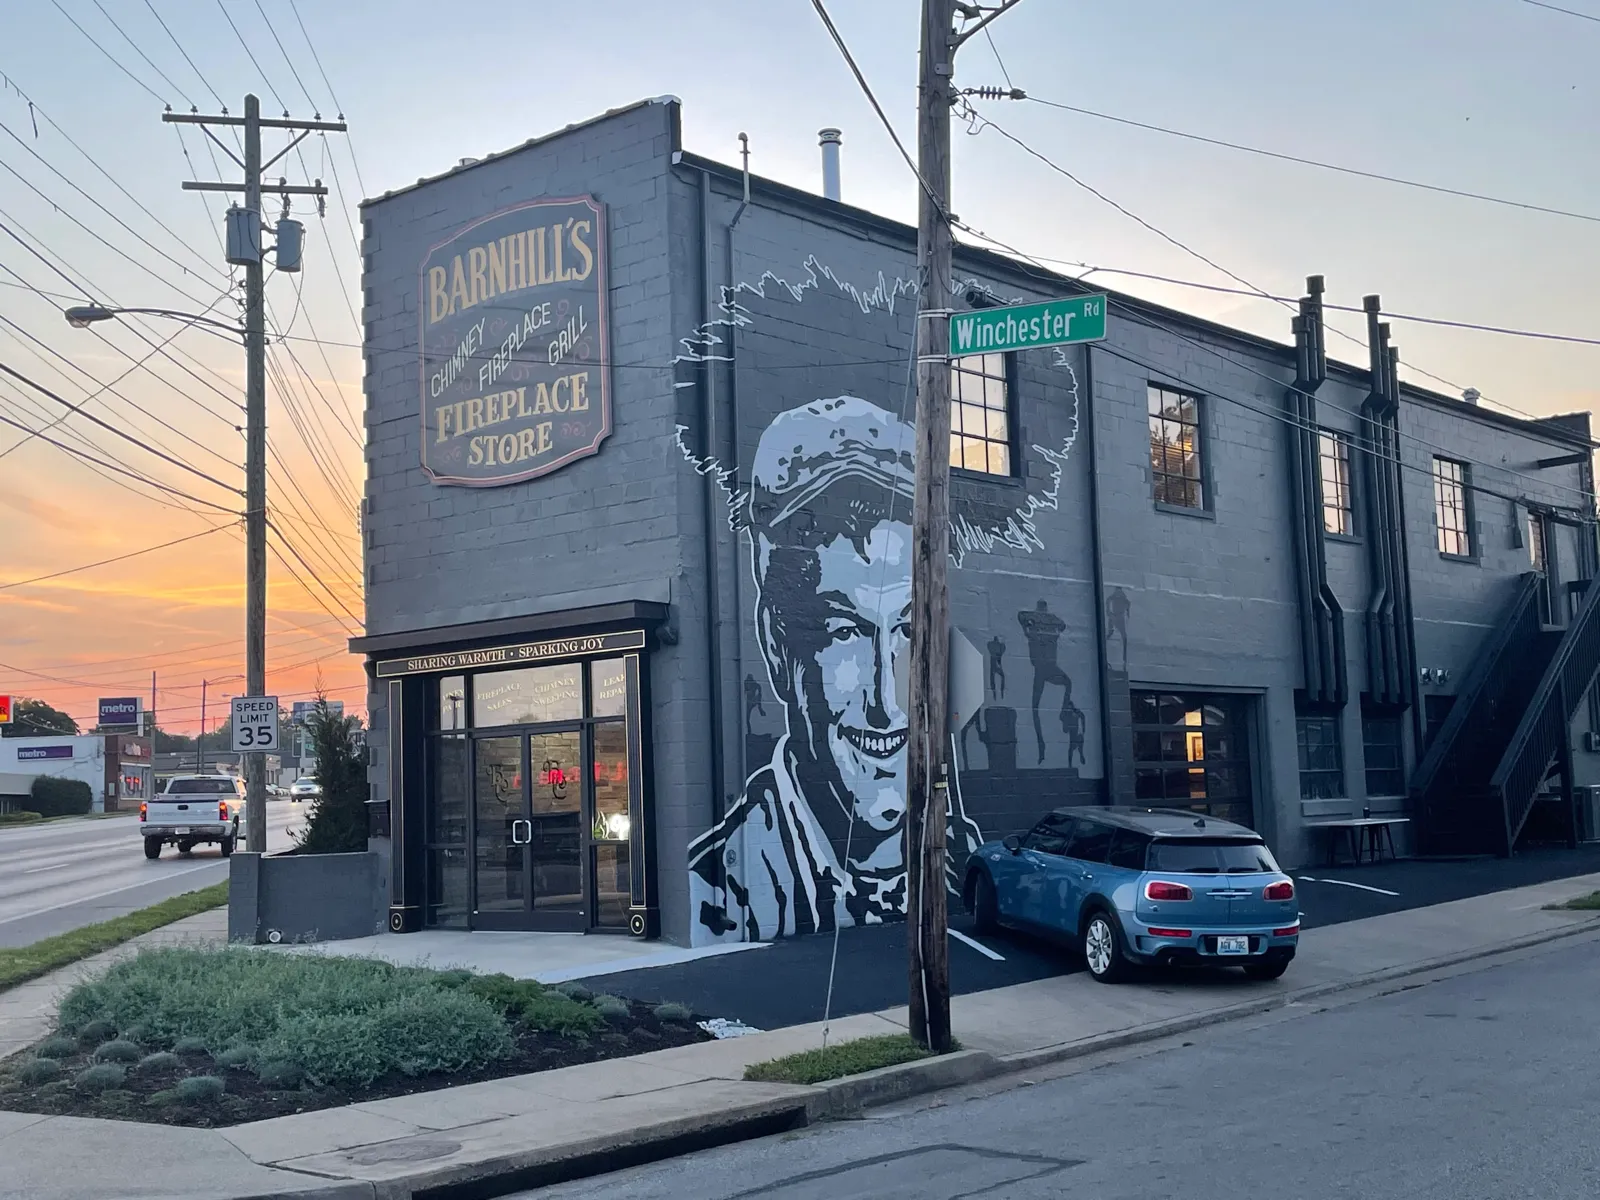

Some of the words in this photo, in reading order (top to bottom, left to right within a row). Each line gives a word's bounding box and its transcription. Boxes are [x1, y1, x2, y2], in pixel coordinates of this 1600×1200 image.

[429, 217, 593, 325] BARNHILL'S
[548, 305, 588, 367] GRILL
[956, 309, 1076, 350] Winchester
[1084, 302, 1099, 317] Rd
[479, 302, 551, 391] FIREPLACE
[431, 317, 486, 398] CHIMNEY
[435, 372, 589, 444] FIREPLACE
[467, 421, 553, 466] STORE
[408, 656, 456, 670] SHARING
[457, 650, 506, 665] WARMTH
[518, 642, 578, 658] SPARKING
[581, 638, 605, 651] JOY
[477, 682, 521, 700] FIREPLACE
[535, 678, 576, 694] CHIMNEY
[236, 702, 274, 712] SPEED
[487, 698, 512, 712] SALES
[533, 690, 578, 706] SWEEPING
[101, 703, 135, 714] metro
[240, 714, 269, 723] LIMIT
[239, 726, 273, 746] 35
[19, 749, 46, 758] metro
